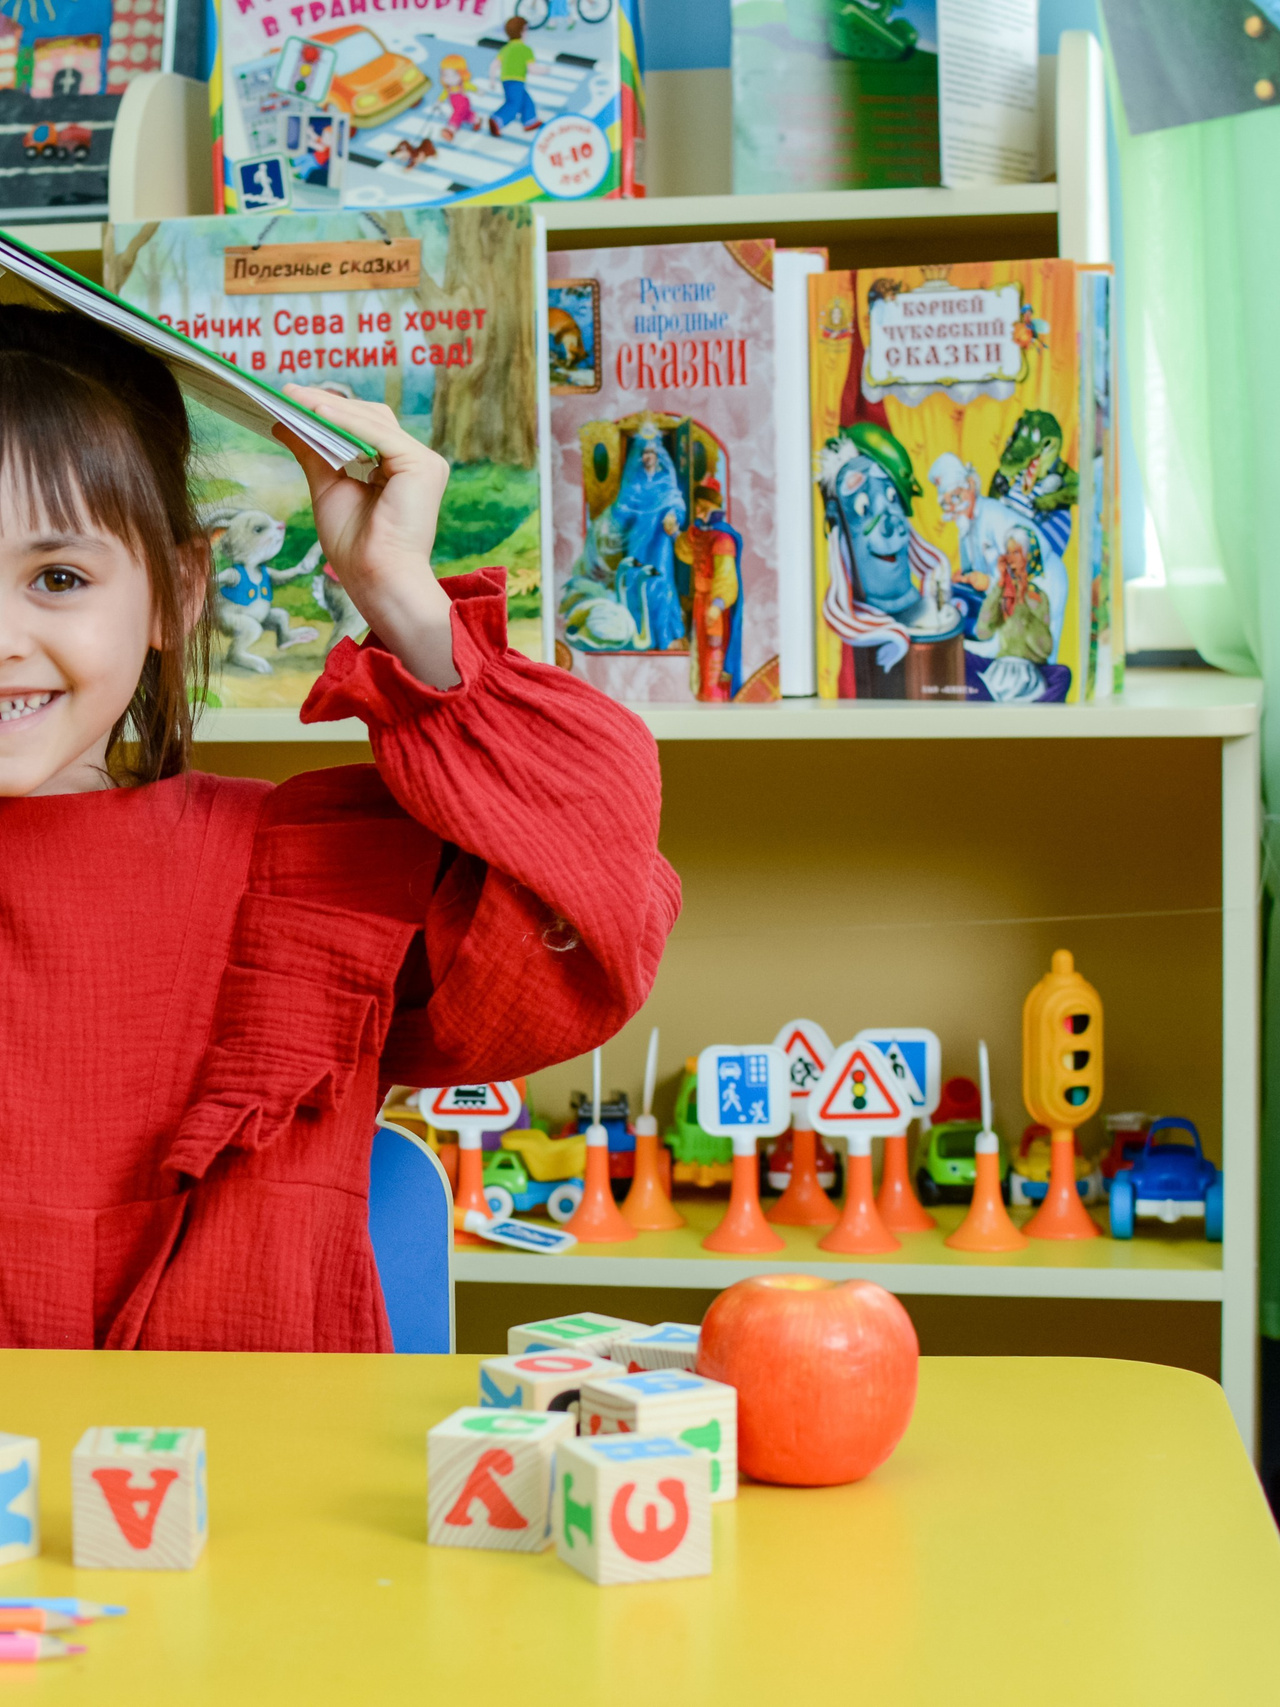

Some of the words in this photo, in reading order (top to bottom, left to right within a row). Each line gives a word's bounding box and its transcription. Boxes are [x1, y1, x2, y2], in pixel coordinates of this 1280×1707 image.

[233, 257, 332, 278] Полезные
[339, 257, 410, 275] сказки
[640, 278, 716, 311] Русские
[902, 295, 984, 317] КОРНЕЙ
[273, 309, 344, 336] Сева
[358, 312, 392, 333] не
[404, 308, 487, 332] хочет
[634, 312, 729, 340] народные
[882, 318, 1005, 343] ЧУКОВСКИЙ
[251, 350, 266, 370] в
[278, 340, 398, 374] детский
[411, 337, 474, 369] сад!
[615, 338, 748, 391] сказки
[885, 343, 1002, 367] СКАЗКИ
[90, 1467, 179, 1551] А
